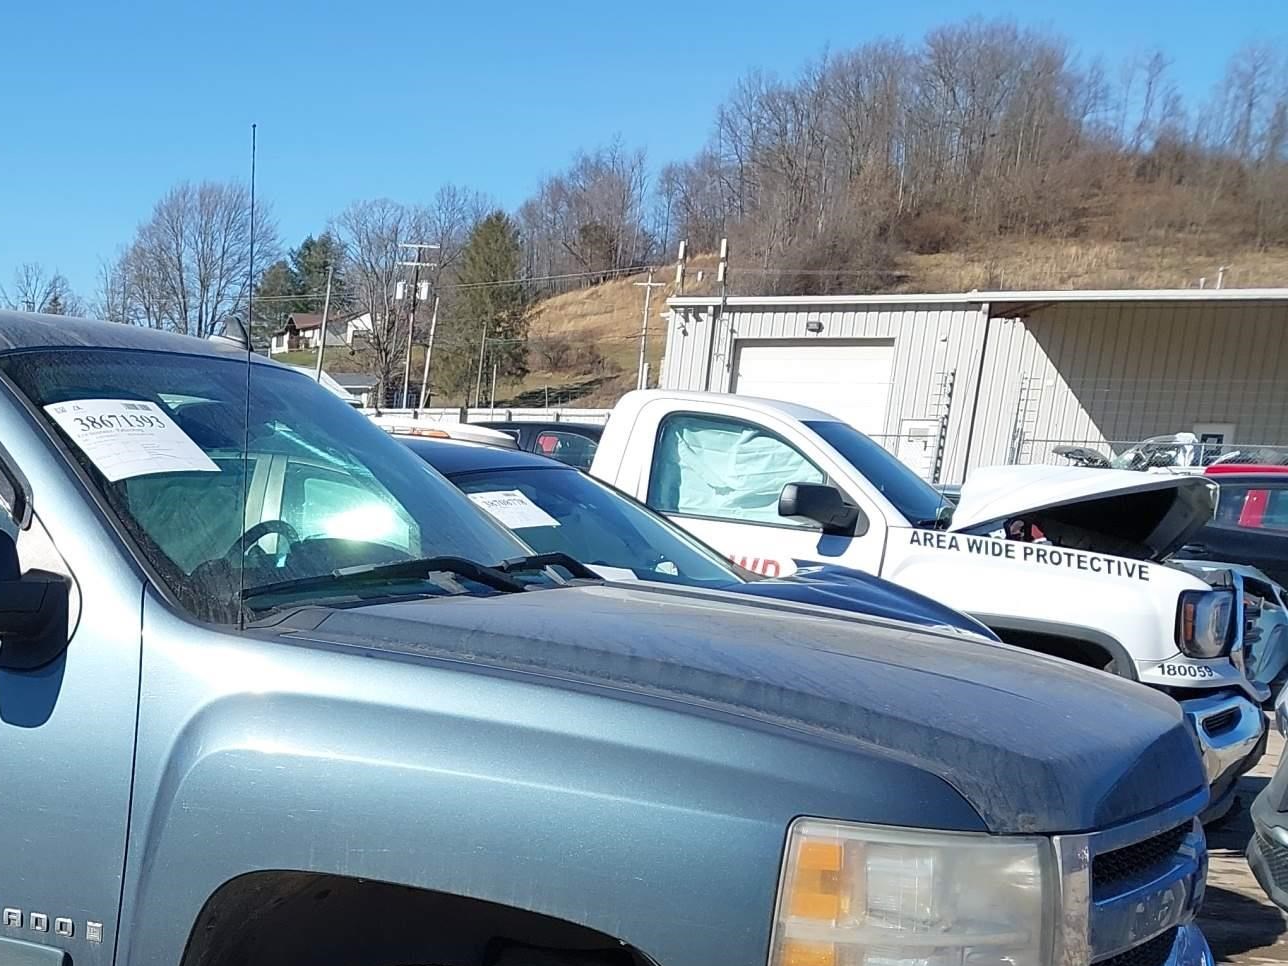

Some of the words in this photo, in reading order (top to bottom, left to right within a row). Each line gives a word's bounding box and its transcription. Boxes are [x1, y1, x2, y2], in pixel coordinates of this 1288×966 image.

[74, 414, 166, 432] 38671393
[909, 530, 961, 552] AREA
[967, 537, 1016, 560] WIDE
[1023, 546, 1150, 582] PROTECTIVE
[1158, 663, 1214, 678] 180059
